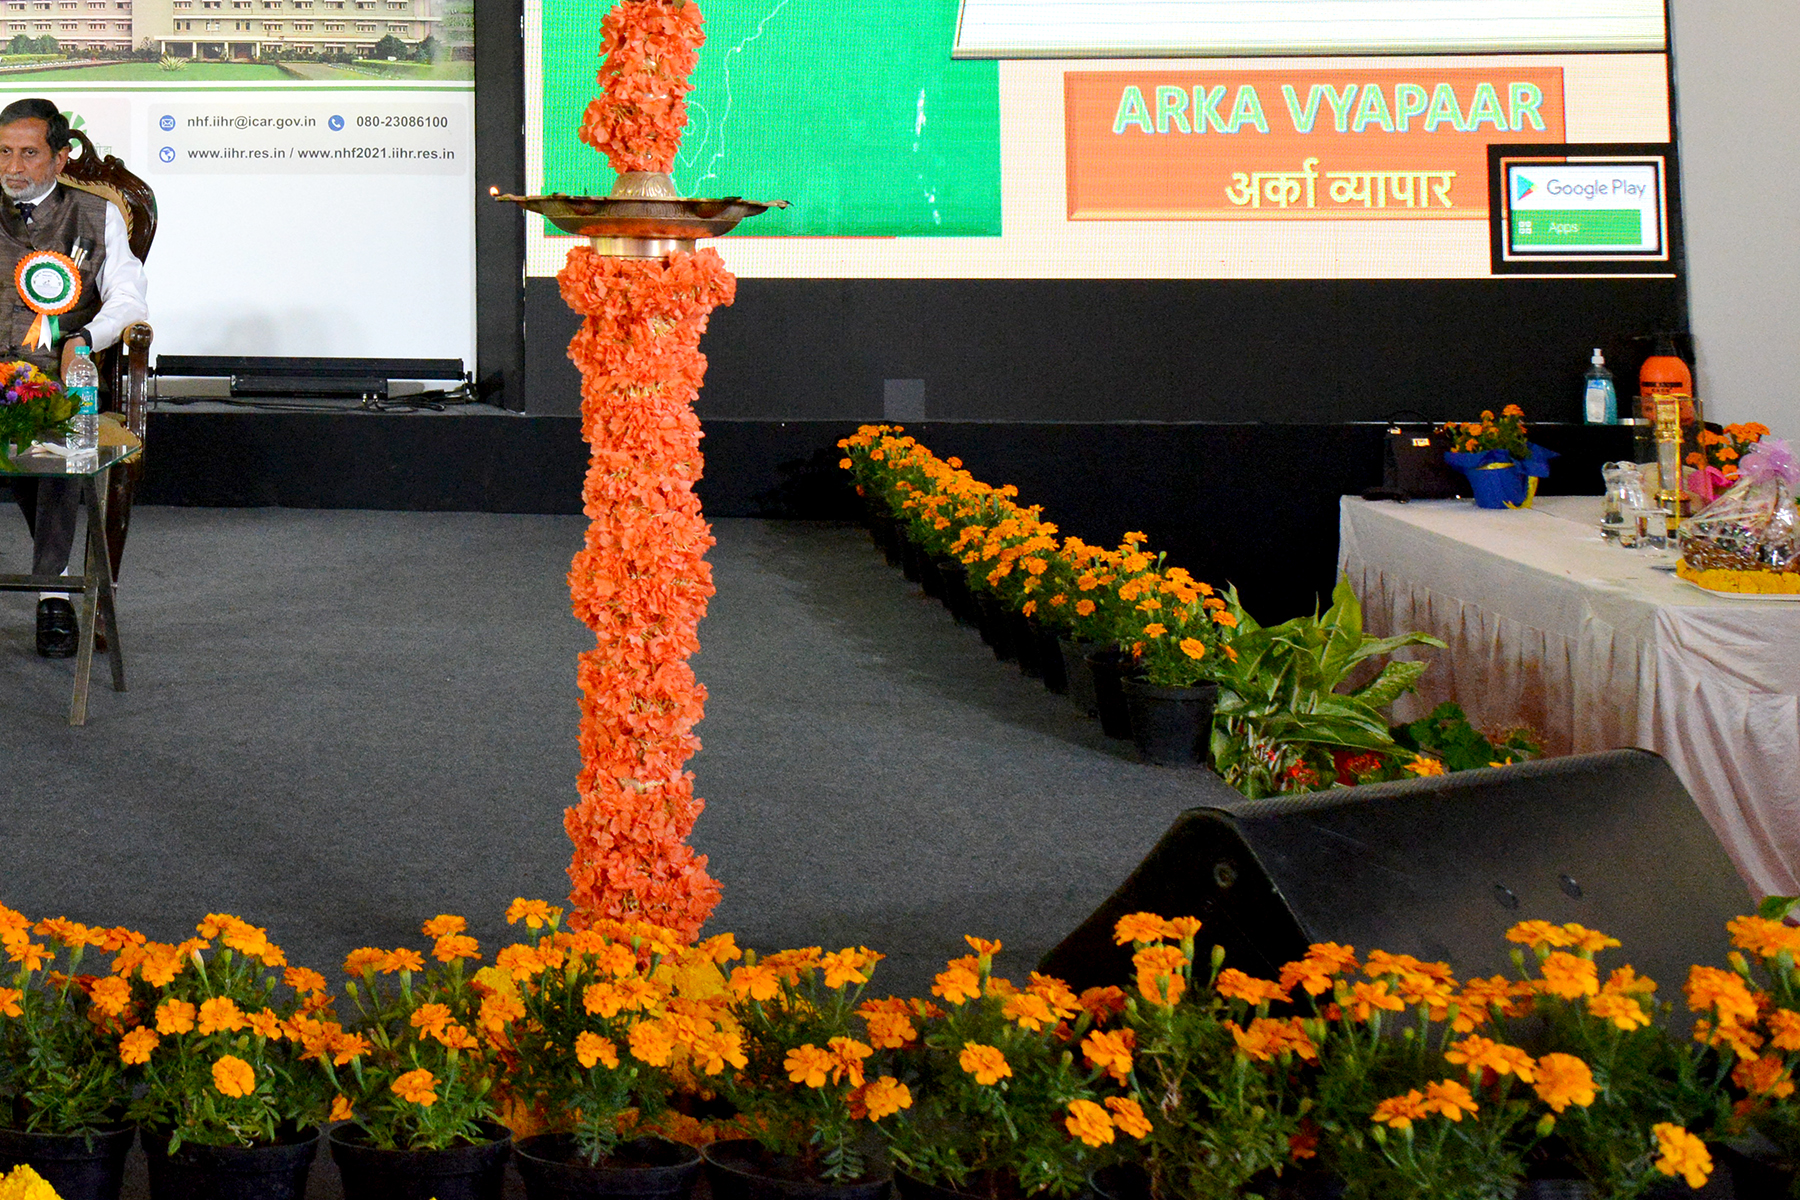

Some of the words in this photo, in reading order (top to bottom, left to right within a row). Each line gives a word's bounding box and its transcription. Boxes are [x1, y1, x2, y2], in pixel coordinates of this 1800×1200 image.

[1112, 84, 1269, 135] ARKA
[1281, 81, 1547, 134] VYAPAAR
[187, 116, 316, 129] nhf.iihr@icar.gov.in
[356, 115, 448, 128] 080-23086100
[187, 147, 286, 159] www.iihr.res.in
[297, 147, 455, 160] www.nhf2021.iihr.res.in
[1224, 157, 1319, 210] अर्का
[1326, 168, 1457, 210] व्यापार
[1546, 177, 1610, 200] Google
[1611, 177, 1647, 202] Play
[1548, 219, 1580, 235] Apps
